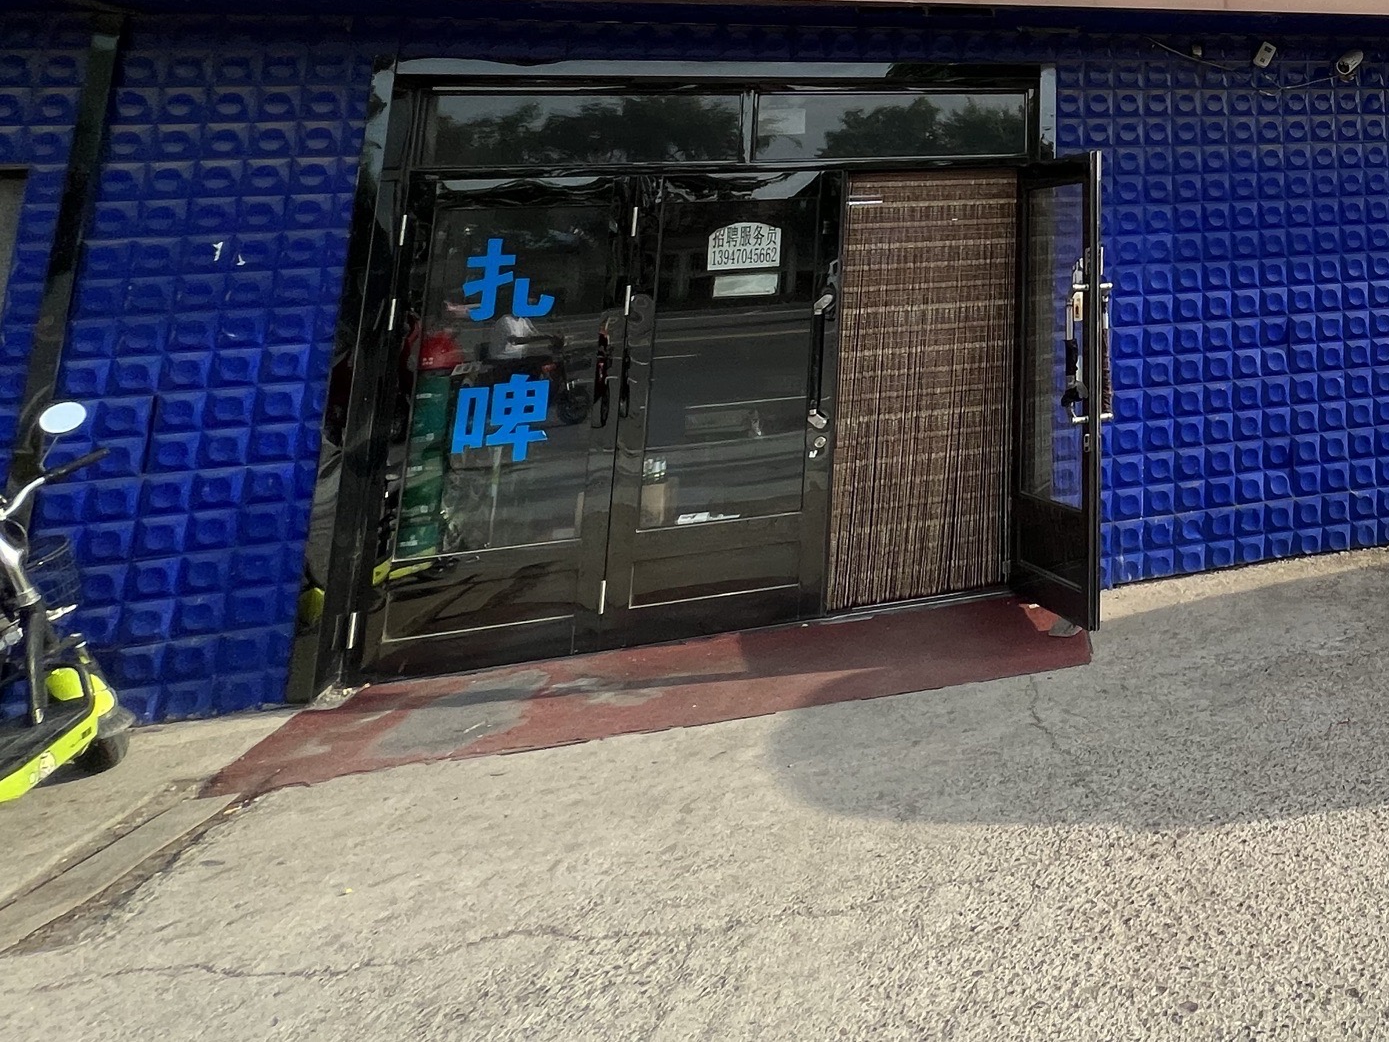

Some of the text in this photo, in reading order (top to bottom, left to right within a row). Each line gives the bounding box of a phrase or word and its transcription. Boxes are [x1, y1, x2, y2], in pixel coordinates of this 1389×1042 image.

[712, 225, 778, 248] 招聘服务员
[712, 247, 777, 266] 13947045662
[451, 238, 555, 462] 扎啤
